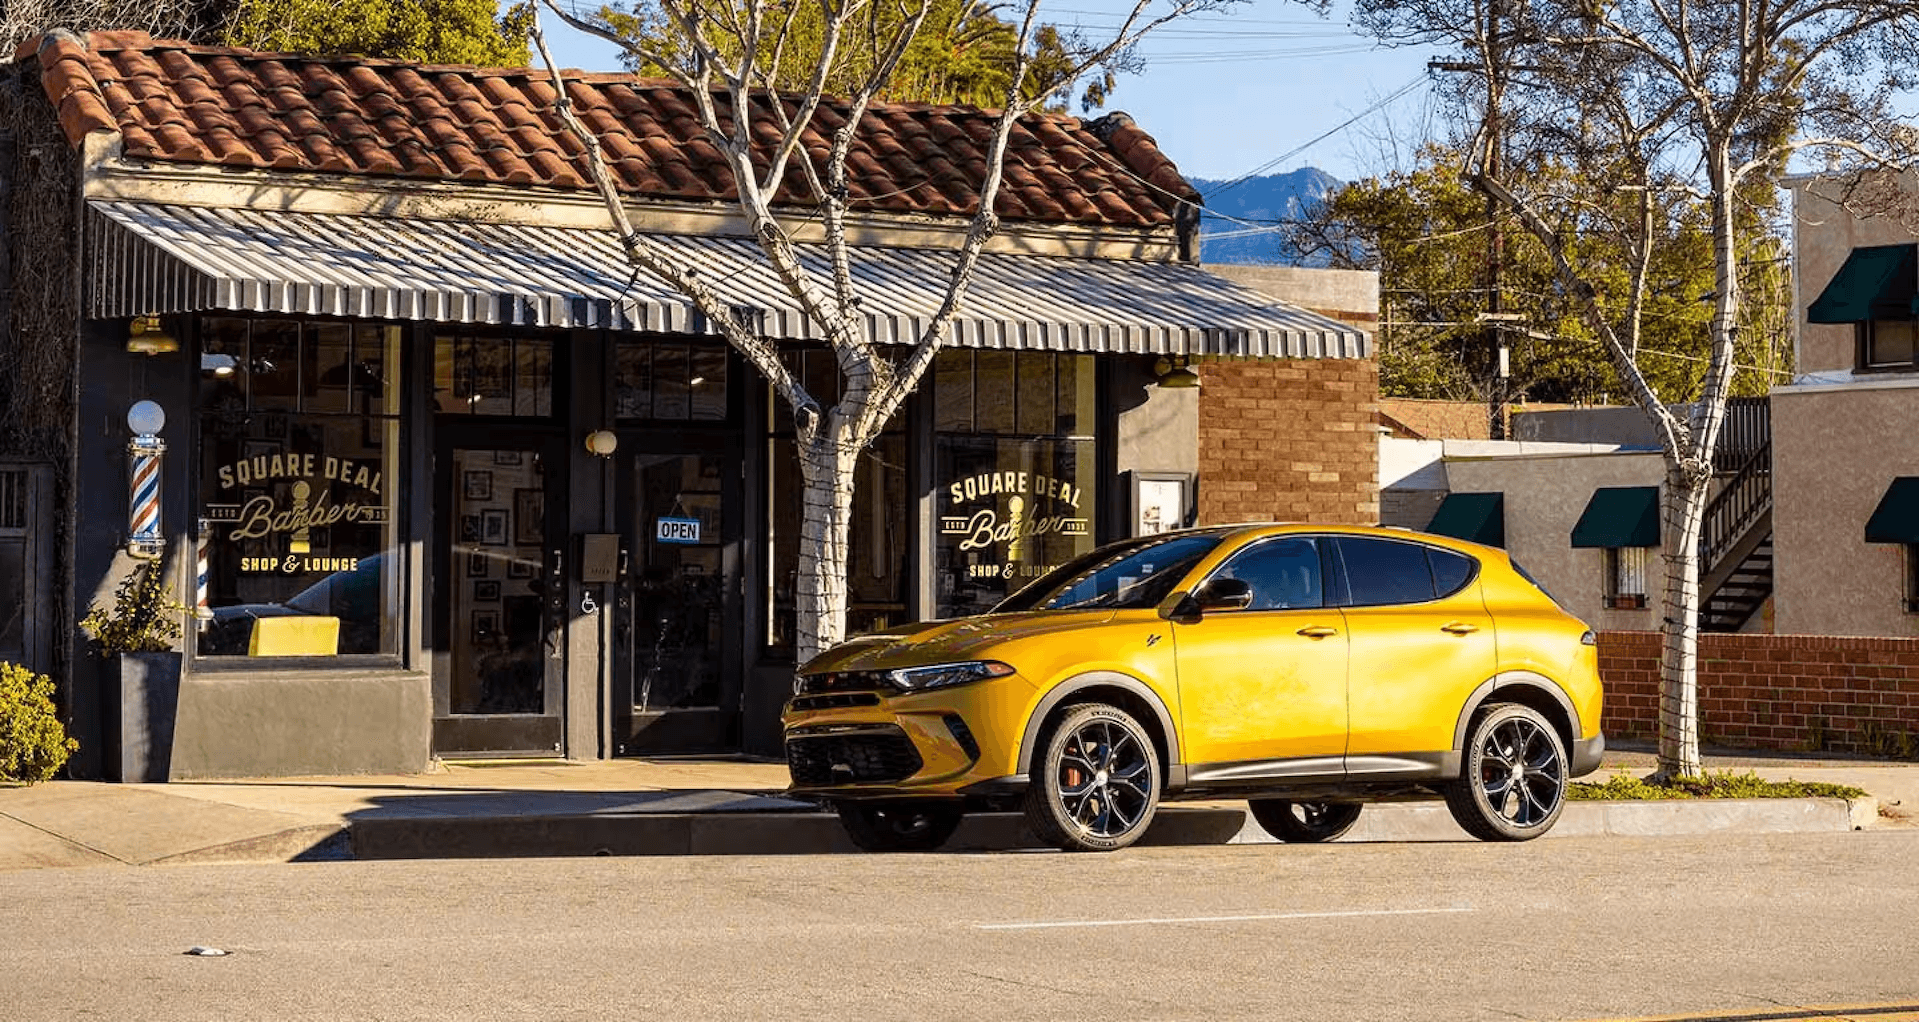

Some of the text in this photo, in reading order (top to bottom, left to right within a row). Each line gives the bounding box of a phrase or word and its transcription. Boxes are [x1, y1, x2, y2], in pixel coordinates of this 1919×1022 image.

[218, 453, 382, 495] SQUARE DEAL
[950, 471, 1082, 509] SQUARE DEAL
[229, 489, 361, 541] Barber
[661, 522, 696, 539] OPEN
[959, 503, 1063, 551] Barber
[241, 554, 358, 573] SHOP & LOUNGE
[969, 564, 1000, 578] SHOP
[1002, 562, 1014, 579] &
